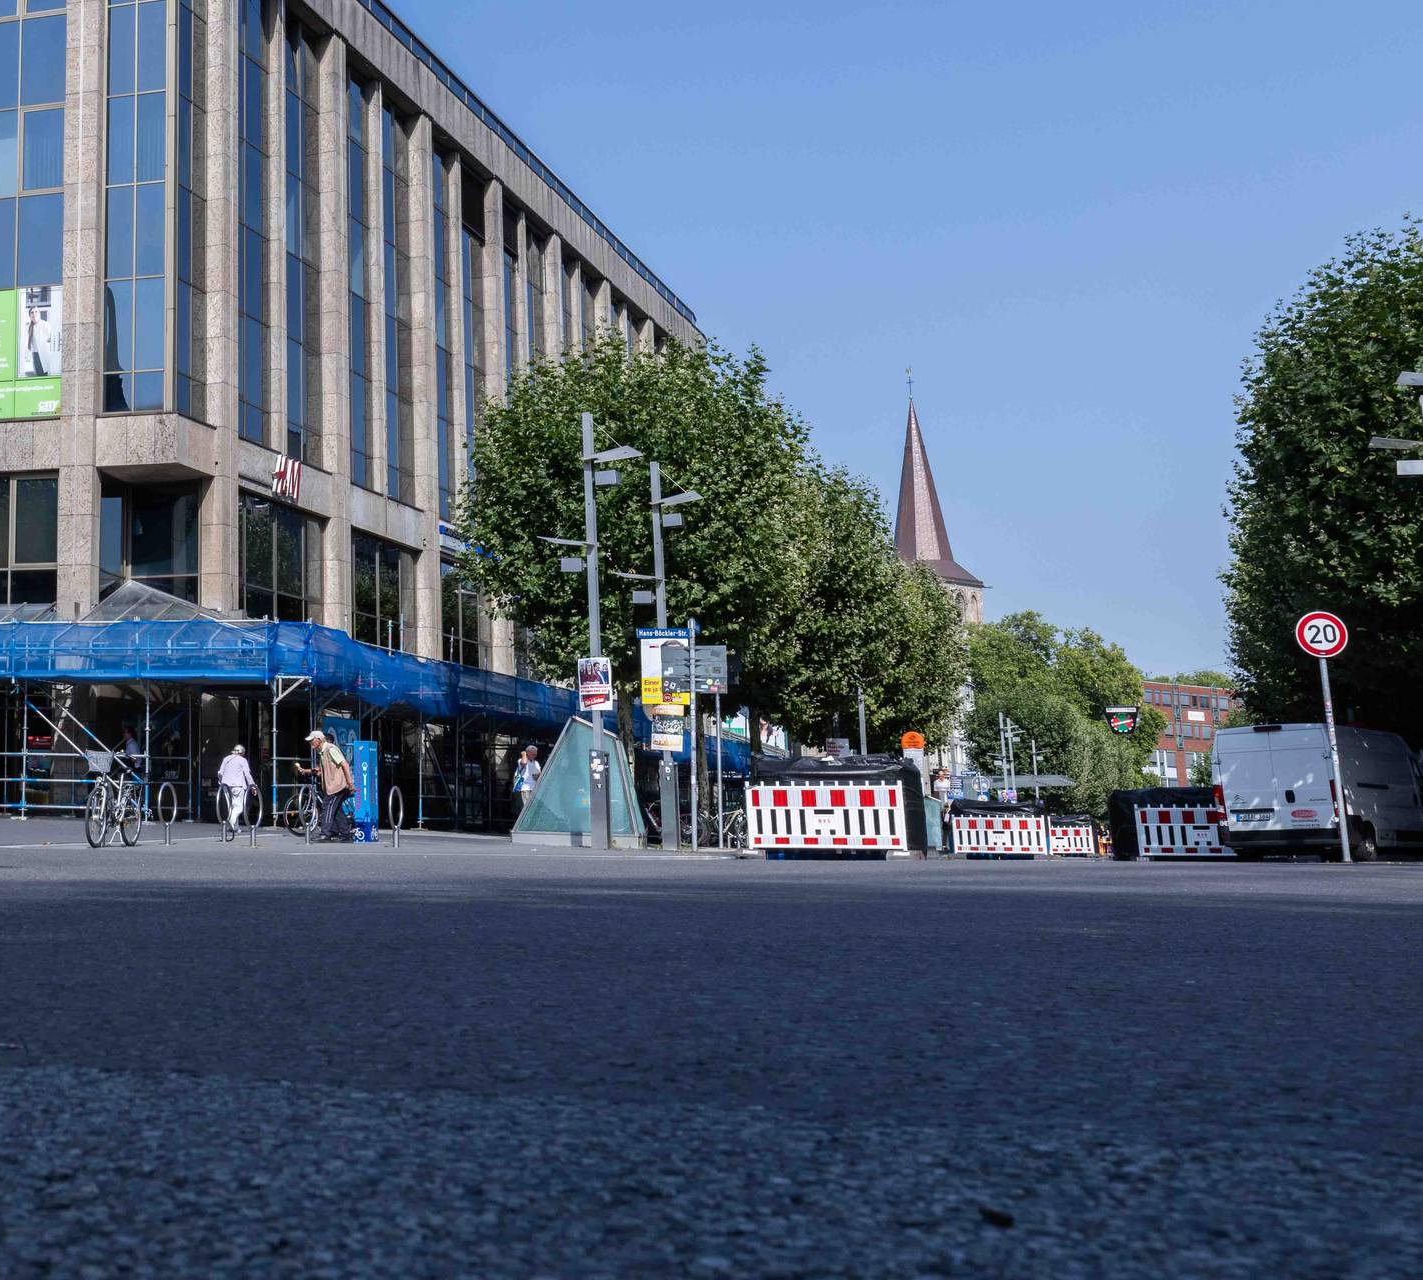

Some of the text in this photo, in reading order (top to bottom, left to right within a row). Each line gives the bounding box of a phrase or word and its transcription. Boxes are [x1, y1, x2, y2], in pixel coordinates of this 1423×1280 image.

[272, 454, 301, 503] H&M
[638, 629, 689, 638] Hans-Böckler-Str.
[1308, 624, 1337, 644] 20
